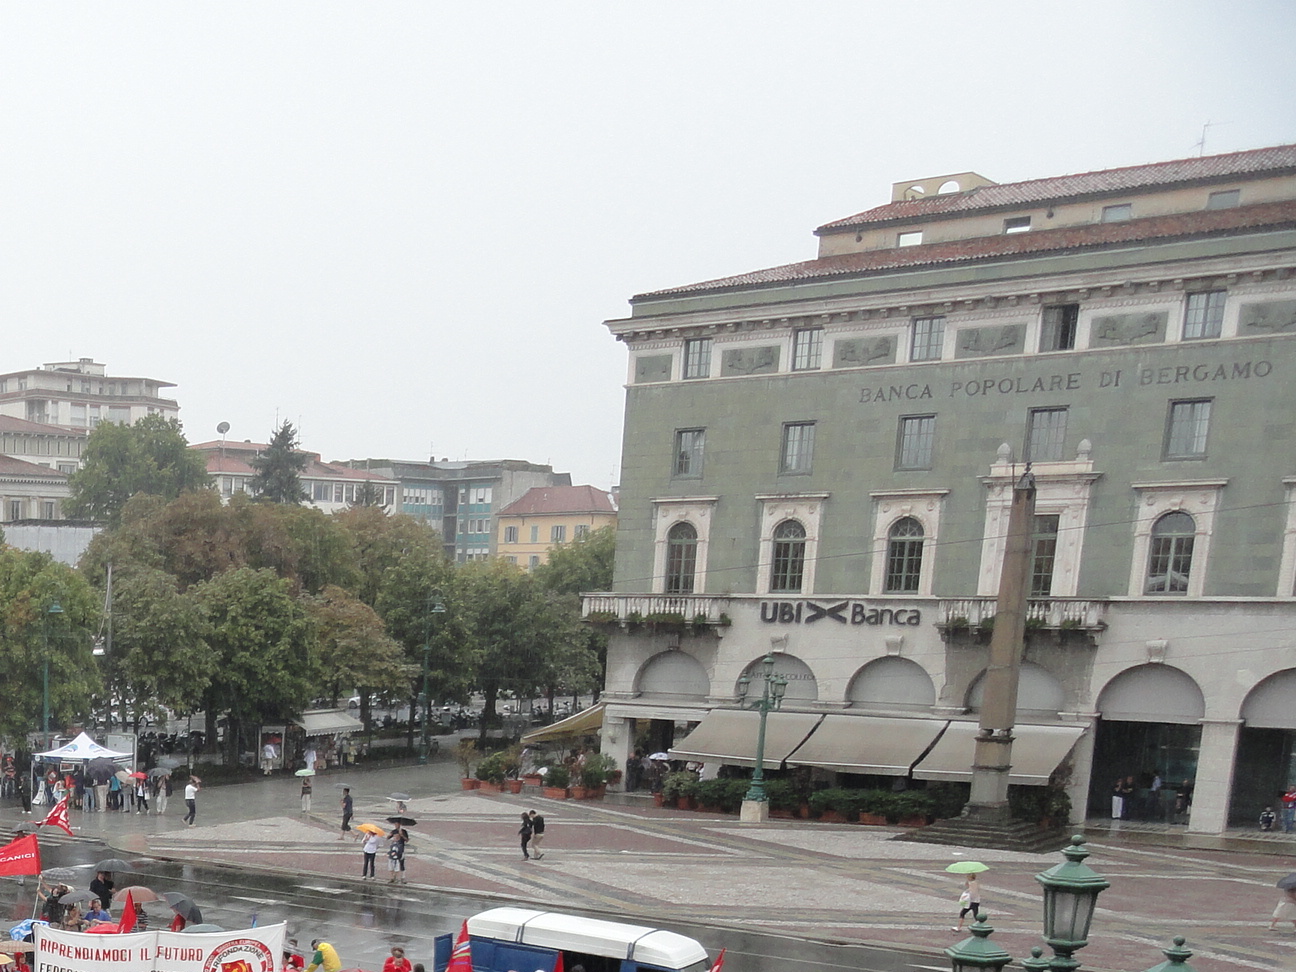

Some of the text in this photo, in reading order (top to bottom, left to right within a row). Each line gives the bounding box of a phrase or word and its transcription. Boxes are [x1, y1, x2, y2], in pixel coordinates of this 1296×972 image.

[859, 360, 1273, 403] BANCA POPOLARE DI BERGAMO
[760, 601, 921, 626] UBI Banca
[40, 939, 203, 962] RIPRENDIAMOCI IL FUTURO
[213, 946, 264, 968] RIFONDAZIONE
